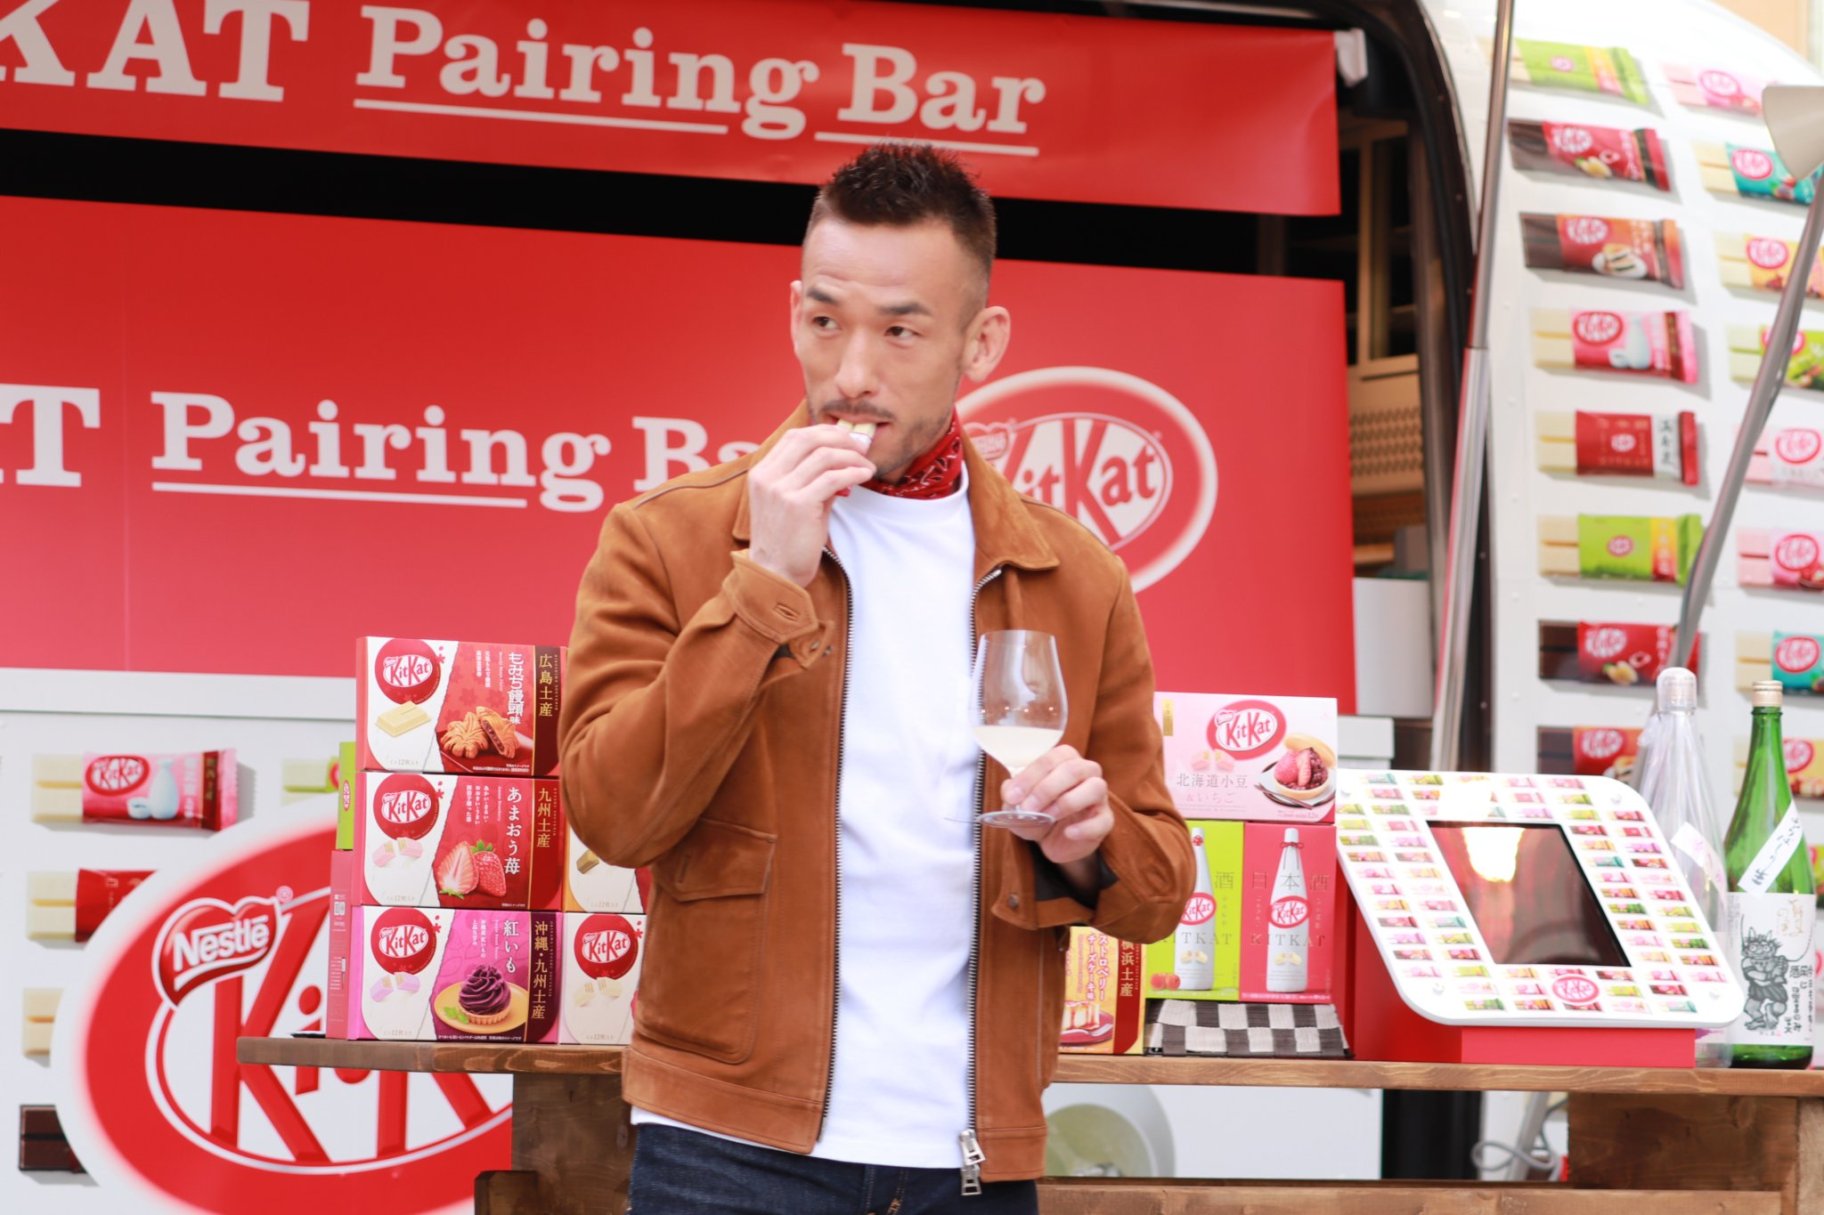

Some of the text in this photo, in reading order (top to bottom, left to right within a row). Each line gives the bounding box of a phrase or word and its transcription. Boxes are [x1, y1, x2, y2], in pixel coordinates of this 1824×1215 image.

[355, 5, 819, 139] Pairing
[837, 43, 1046, 134] Bar
[0, 383, 100, 487] T
[151, 391, 611, 512] Pairing
[390, 655, 429, 686] KitKat
[539, 653, 553, 717] 広島土産
[1226, 711, 1271, 748] KitKat
[388, 791, 428, 822] KitKat
[1177, 773, 1248, 788] 北海道小豆
[504, 786, 522, 875] あまおう苺
[537, 787, 552, 848] 九州土産
[173, 914, 270, 972] Nestlé
[385, 926, 426, 956] KitKat
[503, 920, 519, 973] 紅いも
[588, 931, 627, 962] KitKat
[532, 921, 549, 1019] 沖縄・九州土産
